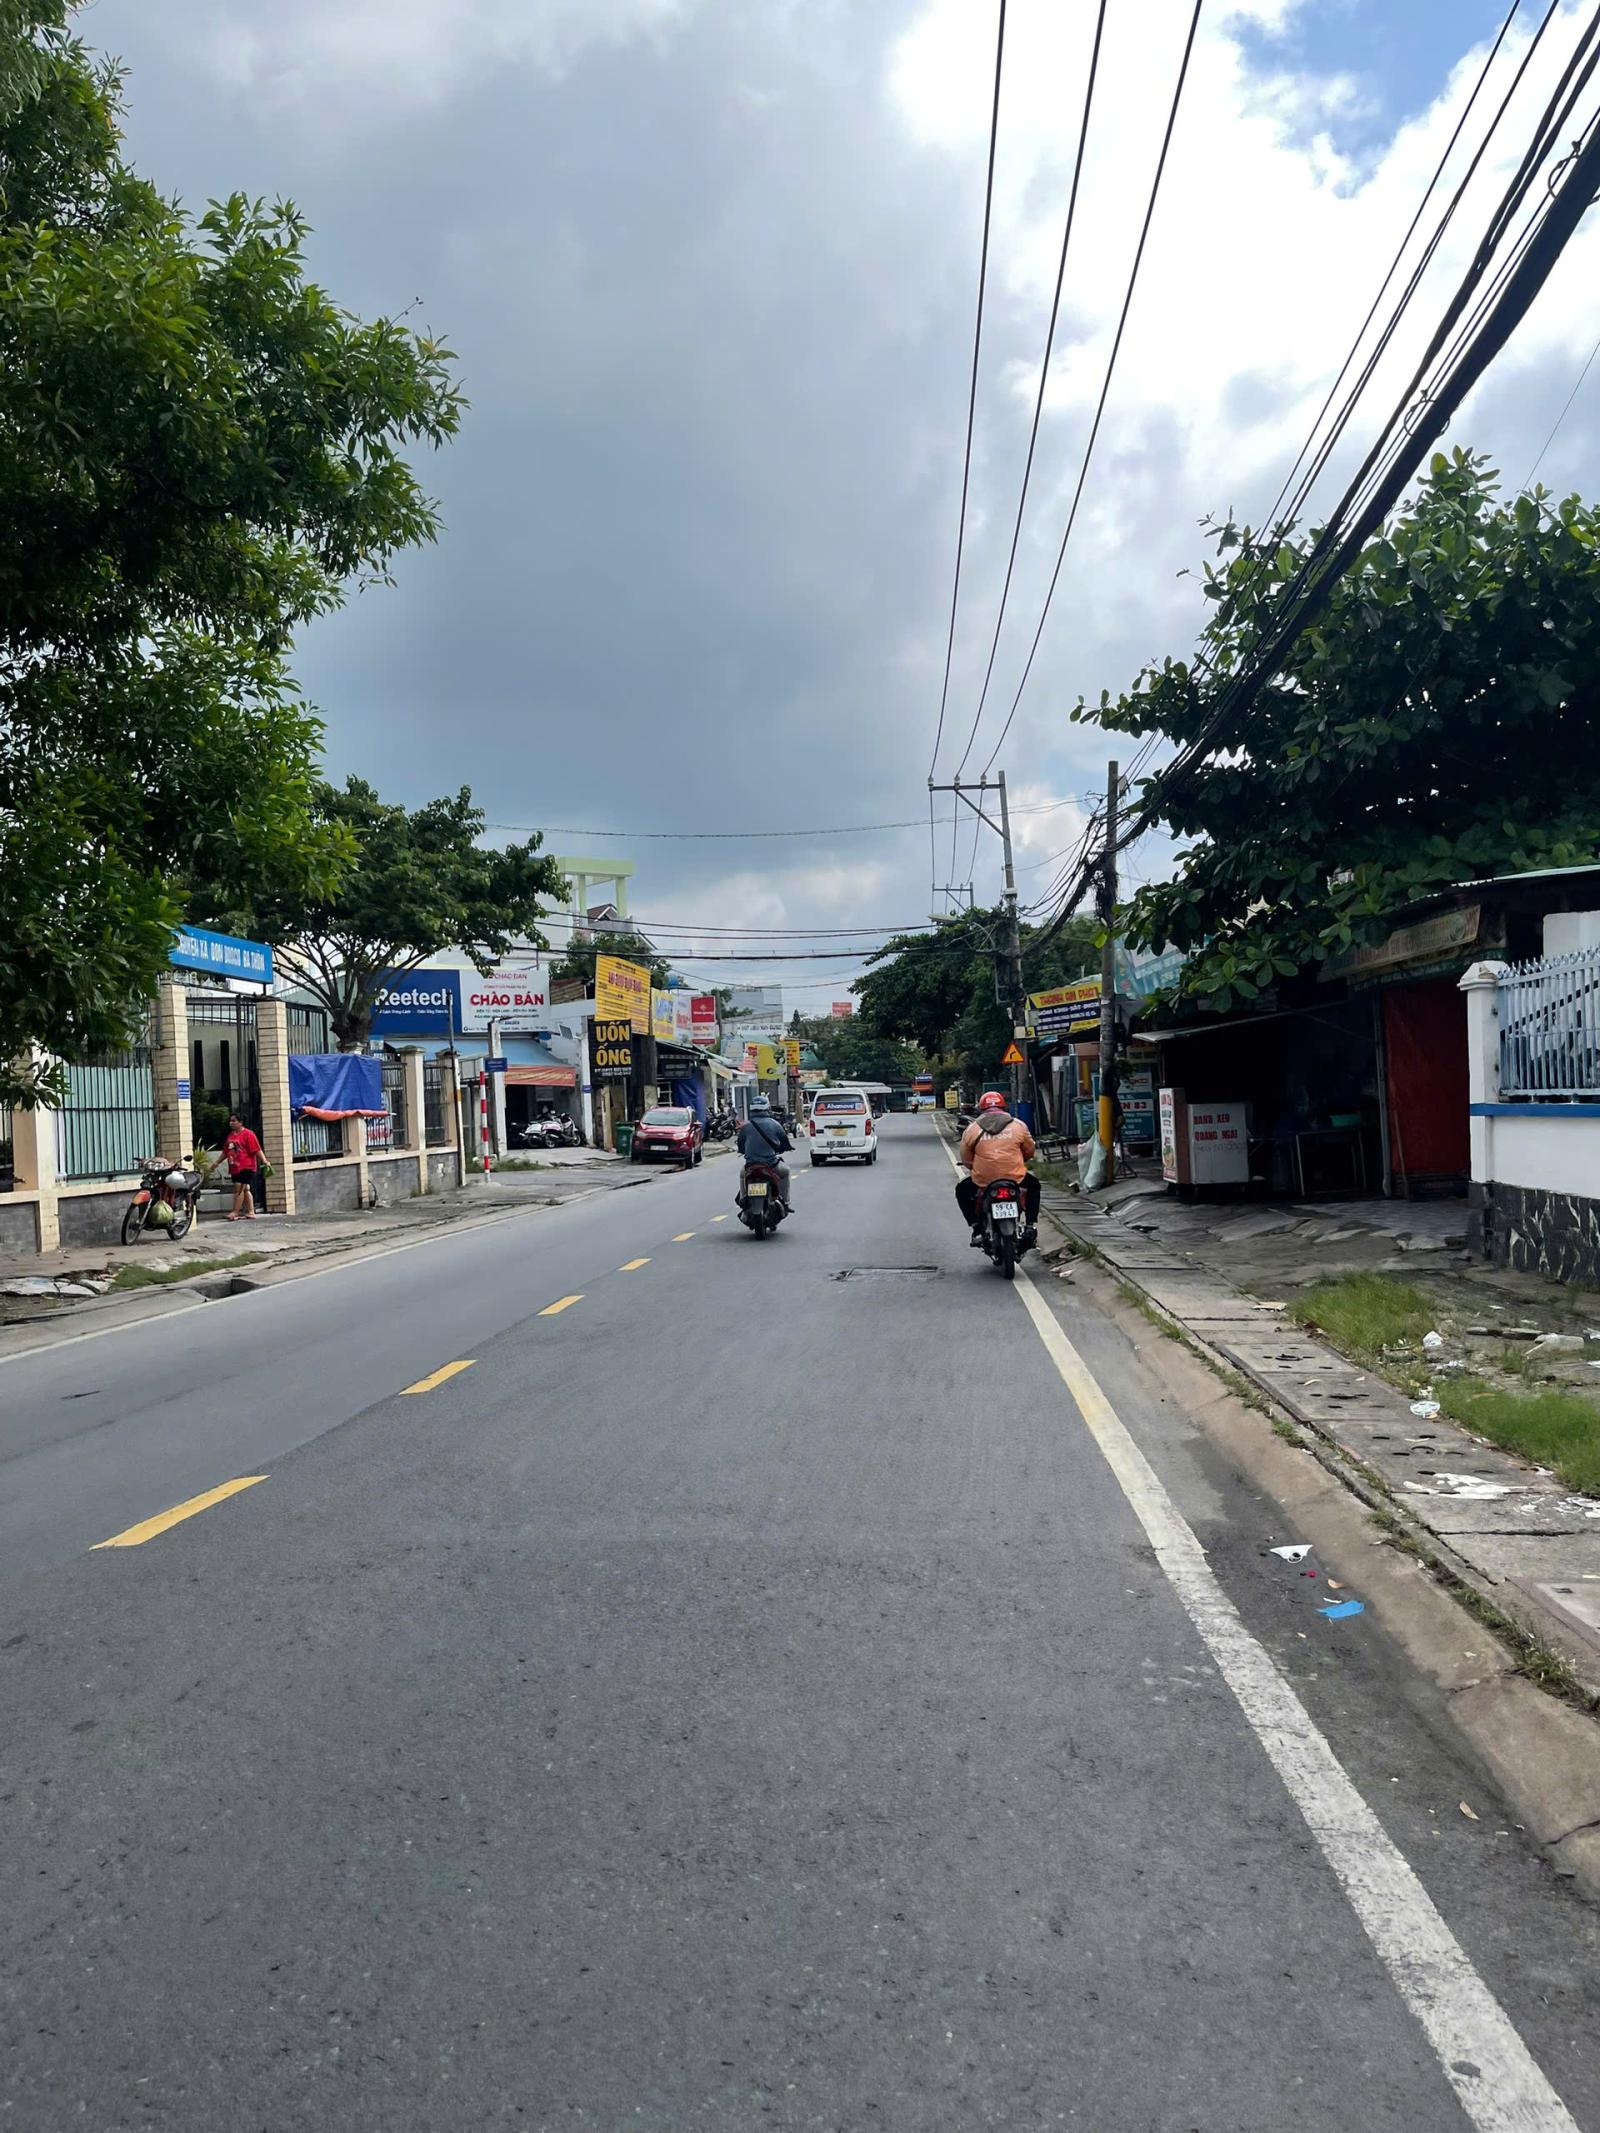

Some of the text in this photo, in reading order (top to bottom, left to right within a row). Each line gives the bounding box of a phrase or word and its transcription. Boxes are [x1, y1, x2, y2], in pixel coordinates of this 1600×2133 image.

[374, 988, 453, 1006] Reetech
[470, 991, 510, 1006] CHÀO
[596, 1021, 630, 1042] UỐN
[596, 1043, 631, 1066] ỐNG
